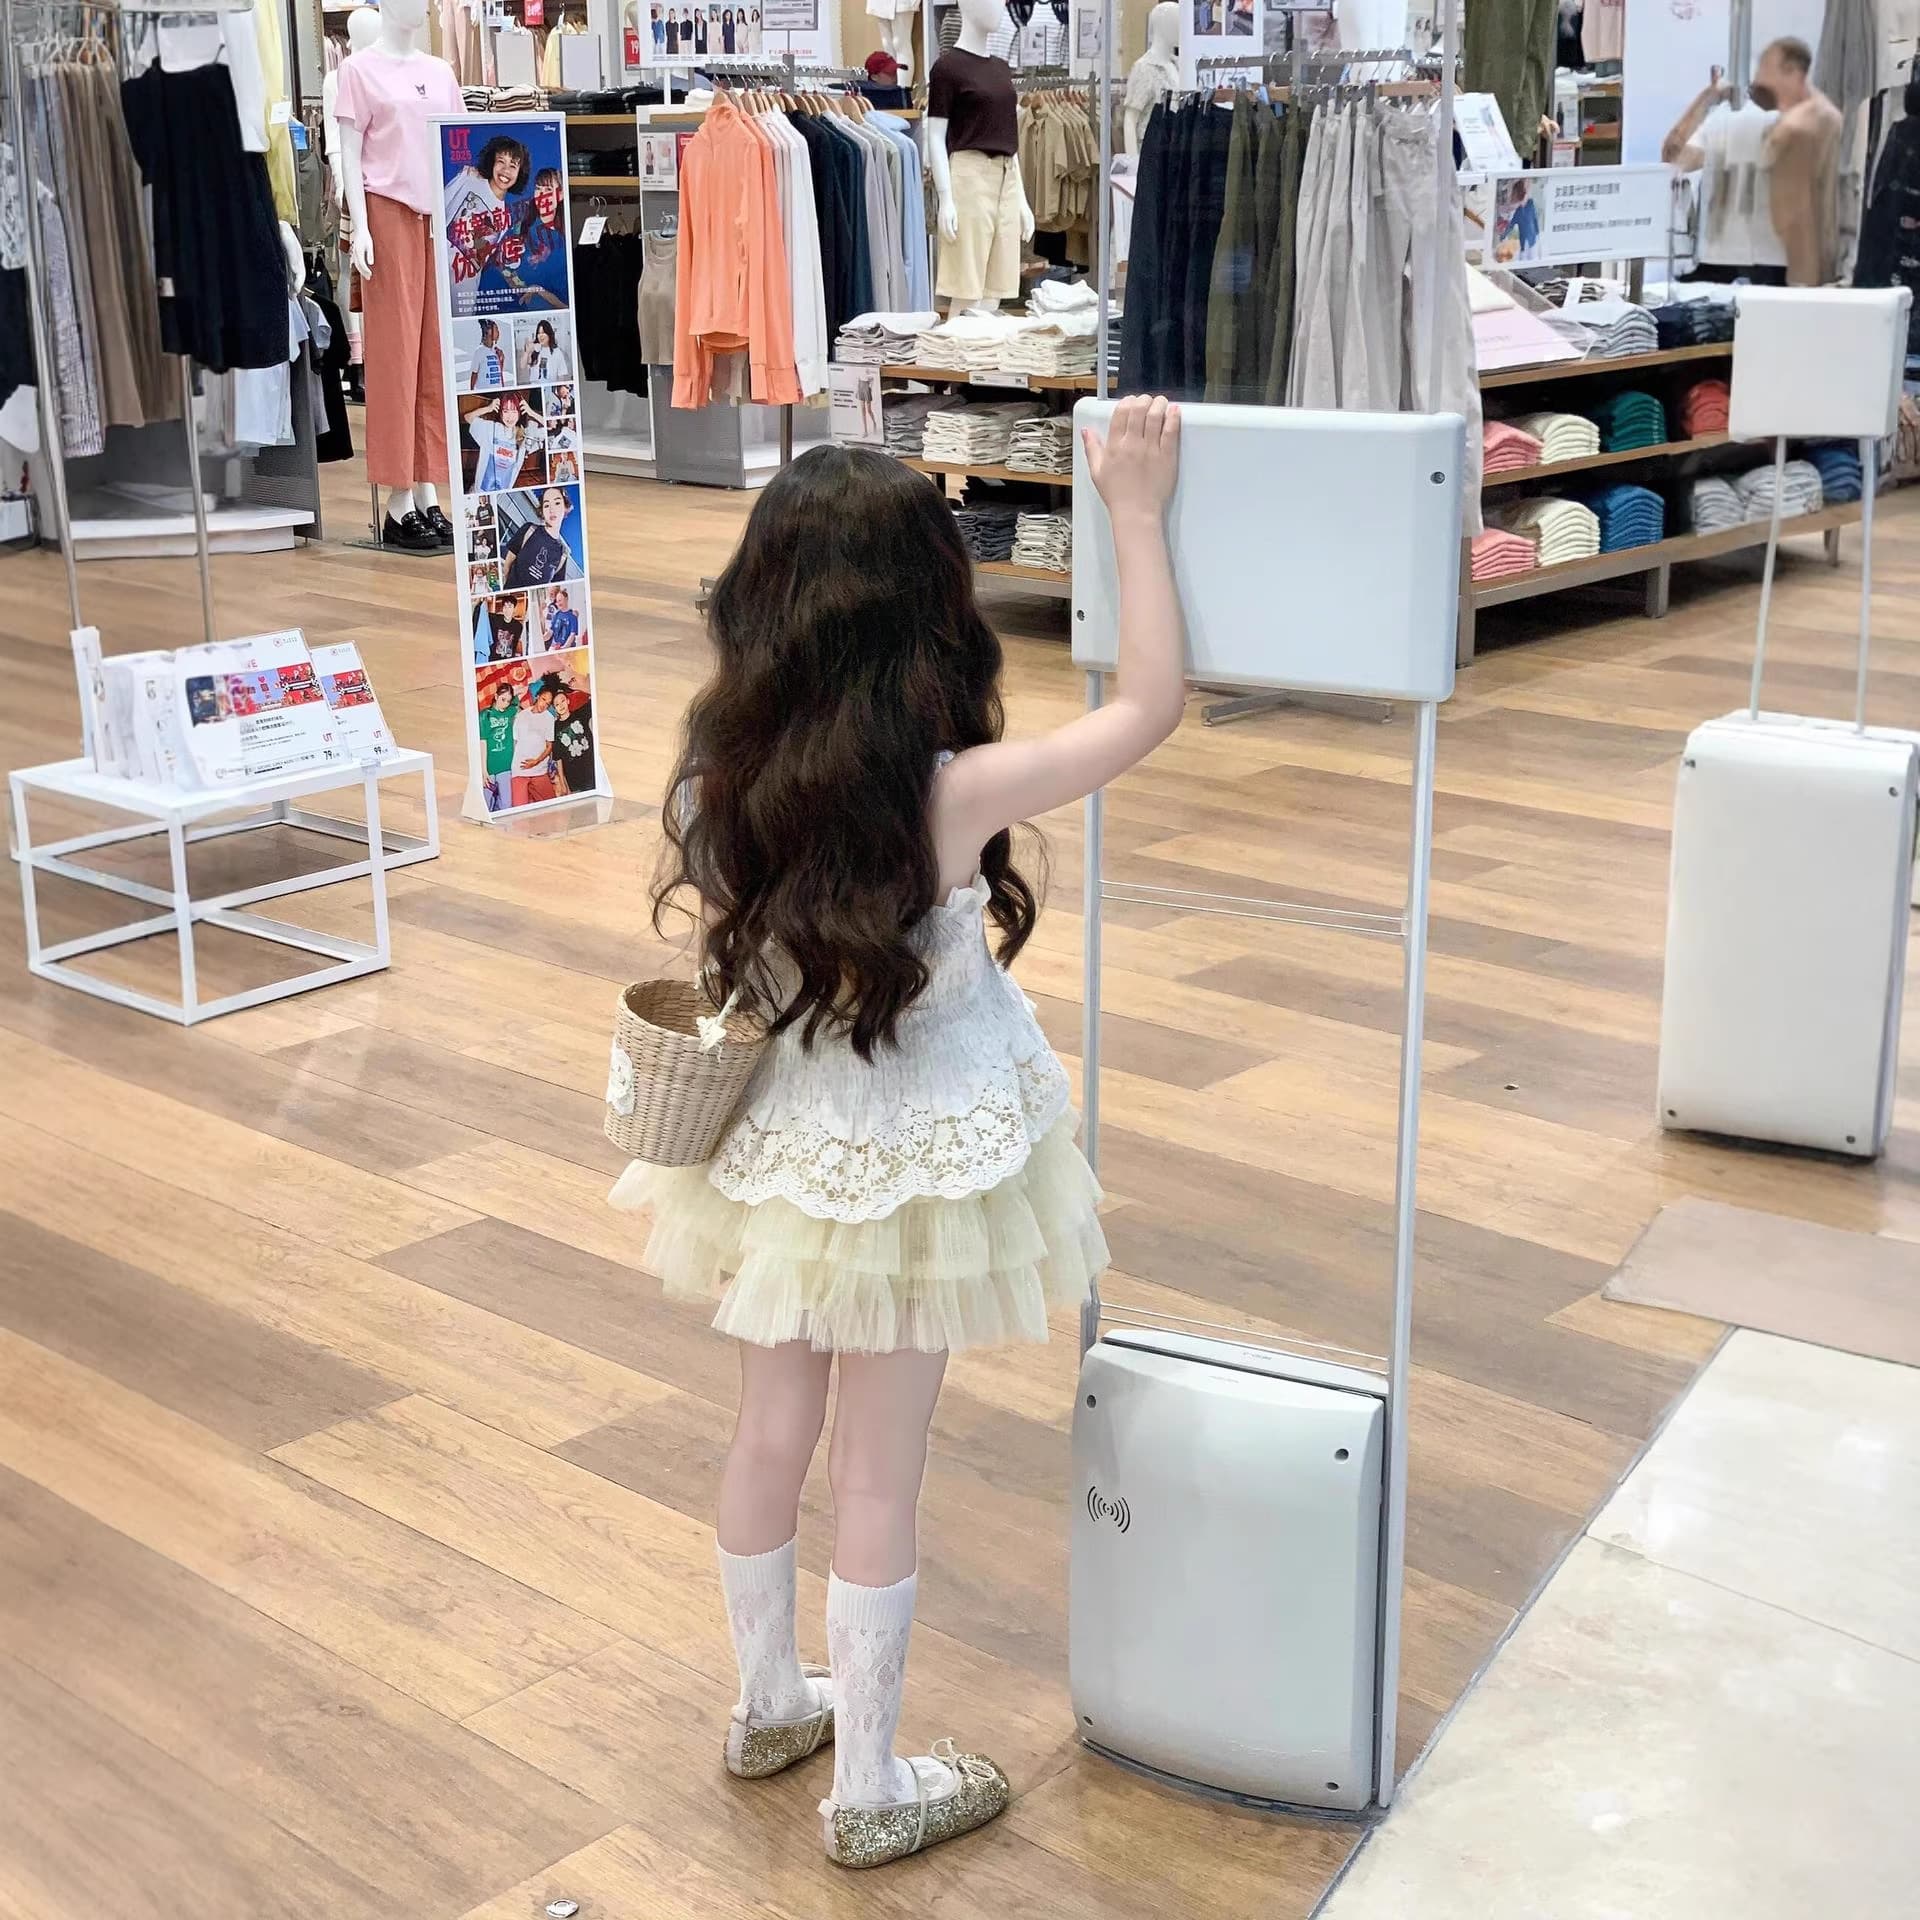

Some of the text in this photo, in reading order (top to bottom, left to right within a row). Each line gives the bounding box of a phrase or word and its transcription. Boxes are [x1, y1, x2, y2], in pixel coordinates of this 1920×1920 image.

[449, 128, 471, 150] UT
[450, 150, 472, 161] 2025
[322, 732, 334, 743] UT
